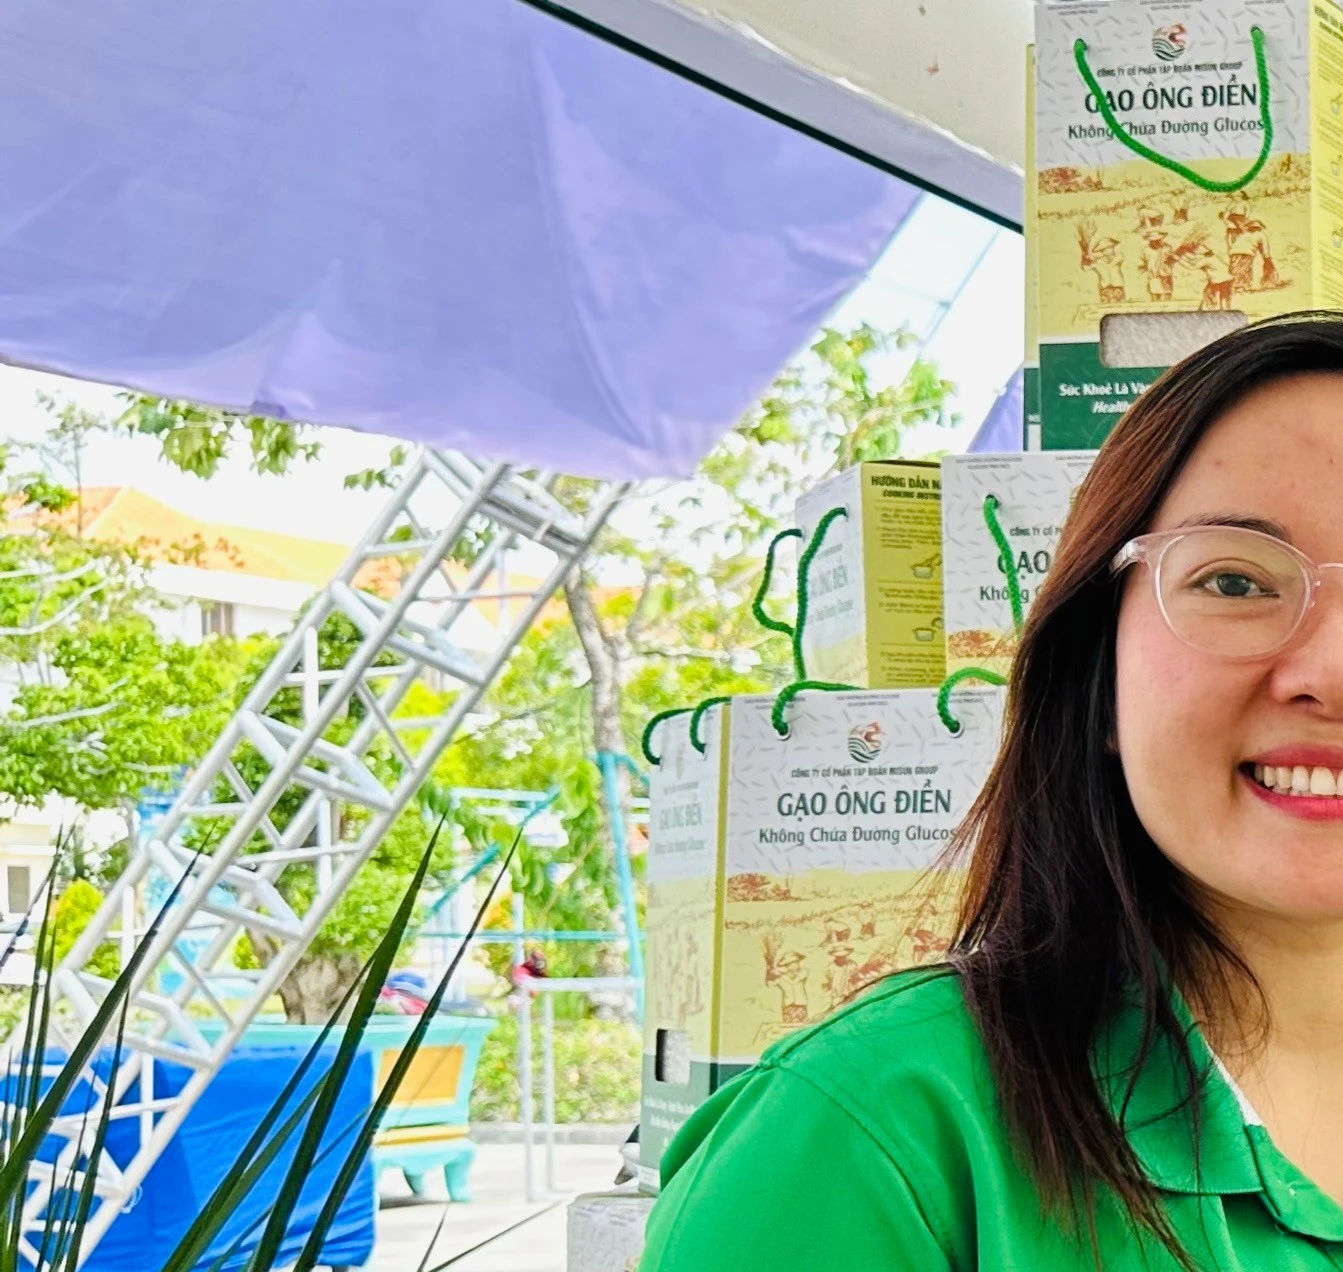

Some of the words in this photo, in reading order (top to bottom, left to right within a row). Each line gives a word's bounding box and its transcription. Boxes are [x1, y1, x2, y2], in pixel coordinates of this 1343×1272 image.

[1143, 82, 1193, 110] ÔNG
[1068, 124, 1115, 140] Không
[777, 791, 827, 822] GẠO
[835, 784, 886, 815] ÔNG
[759, 828, 805, 845] Không
